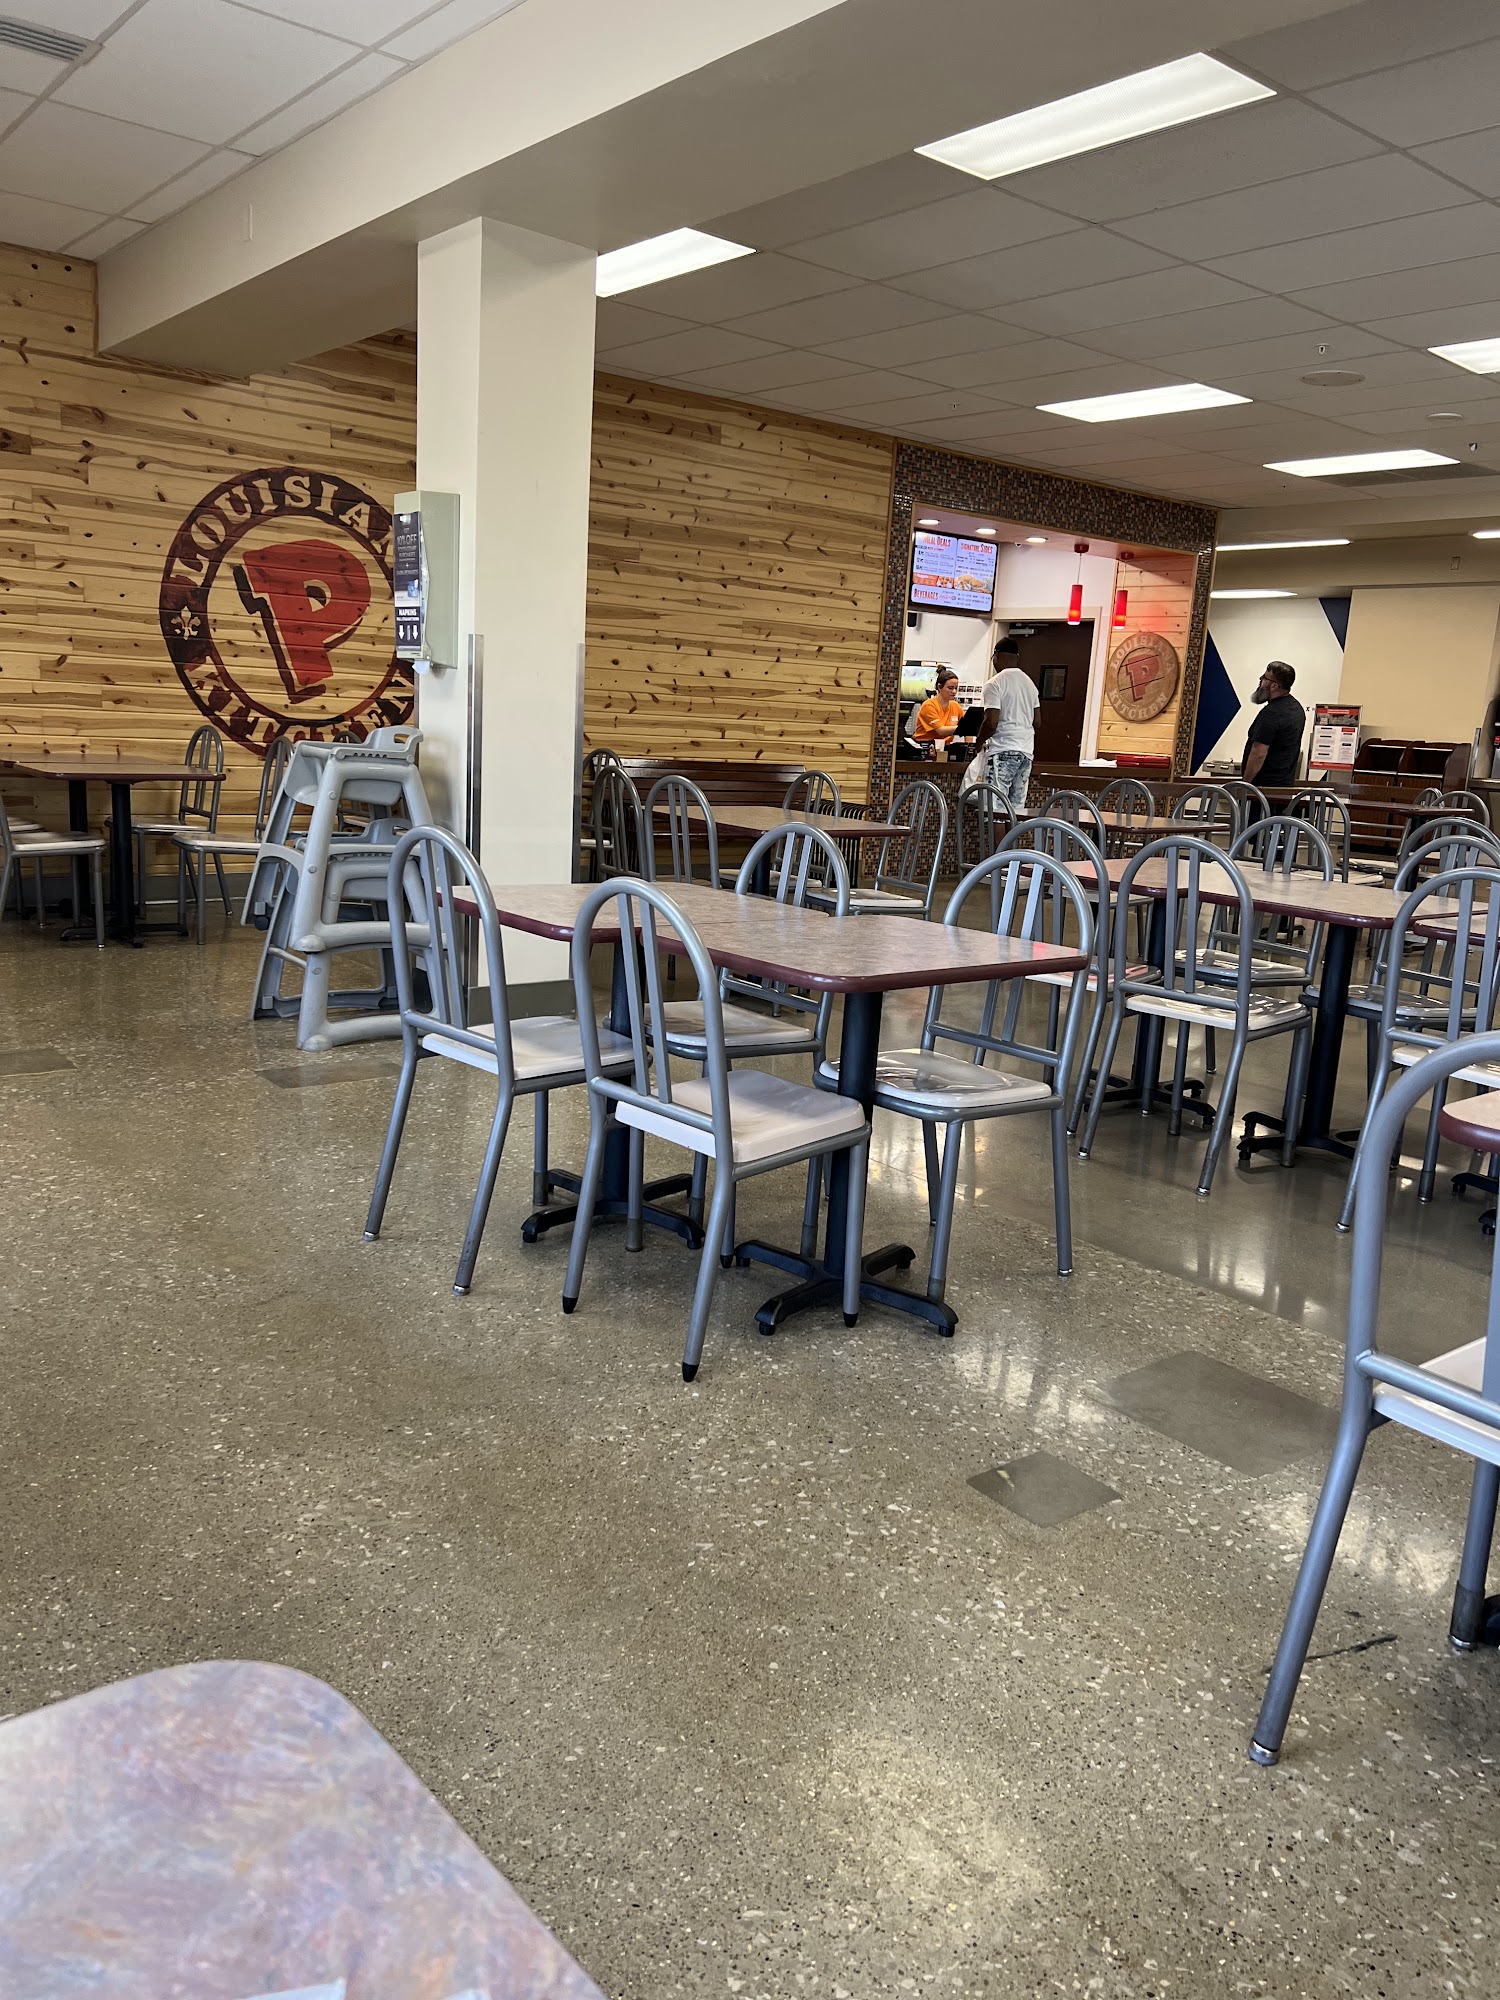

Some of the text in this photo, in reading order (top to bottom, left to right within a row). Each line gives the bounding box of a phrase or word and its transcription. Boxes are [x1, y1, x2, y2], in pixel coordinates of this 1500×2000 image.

[170, 475, 393, 587] LOUISIA
[406, 534, 417, 545] OFF
[937, 536, 951, 547] DEALS
[980, 543, 993, 554] SIDES
[914, 588, 938, 601] BEVERAGES
[234, 539, 371, 704] P
[1110, 635, 1175, 673] LOUISIANA
[1126, 654, 1159, 702] P
[1108, 688, 1168, 719] KITCHEN
